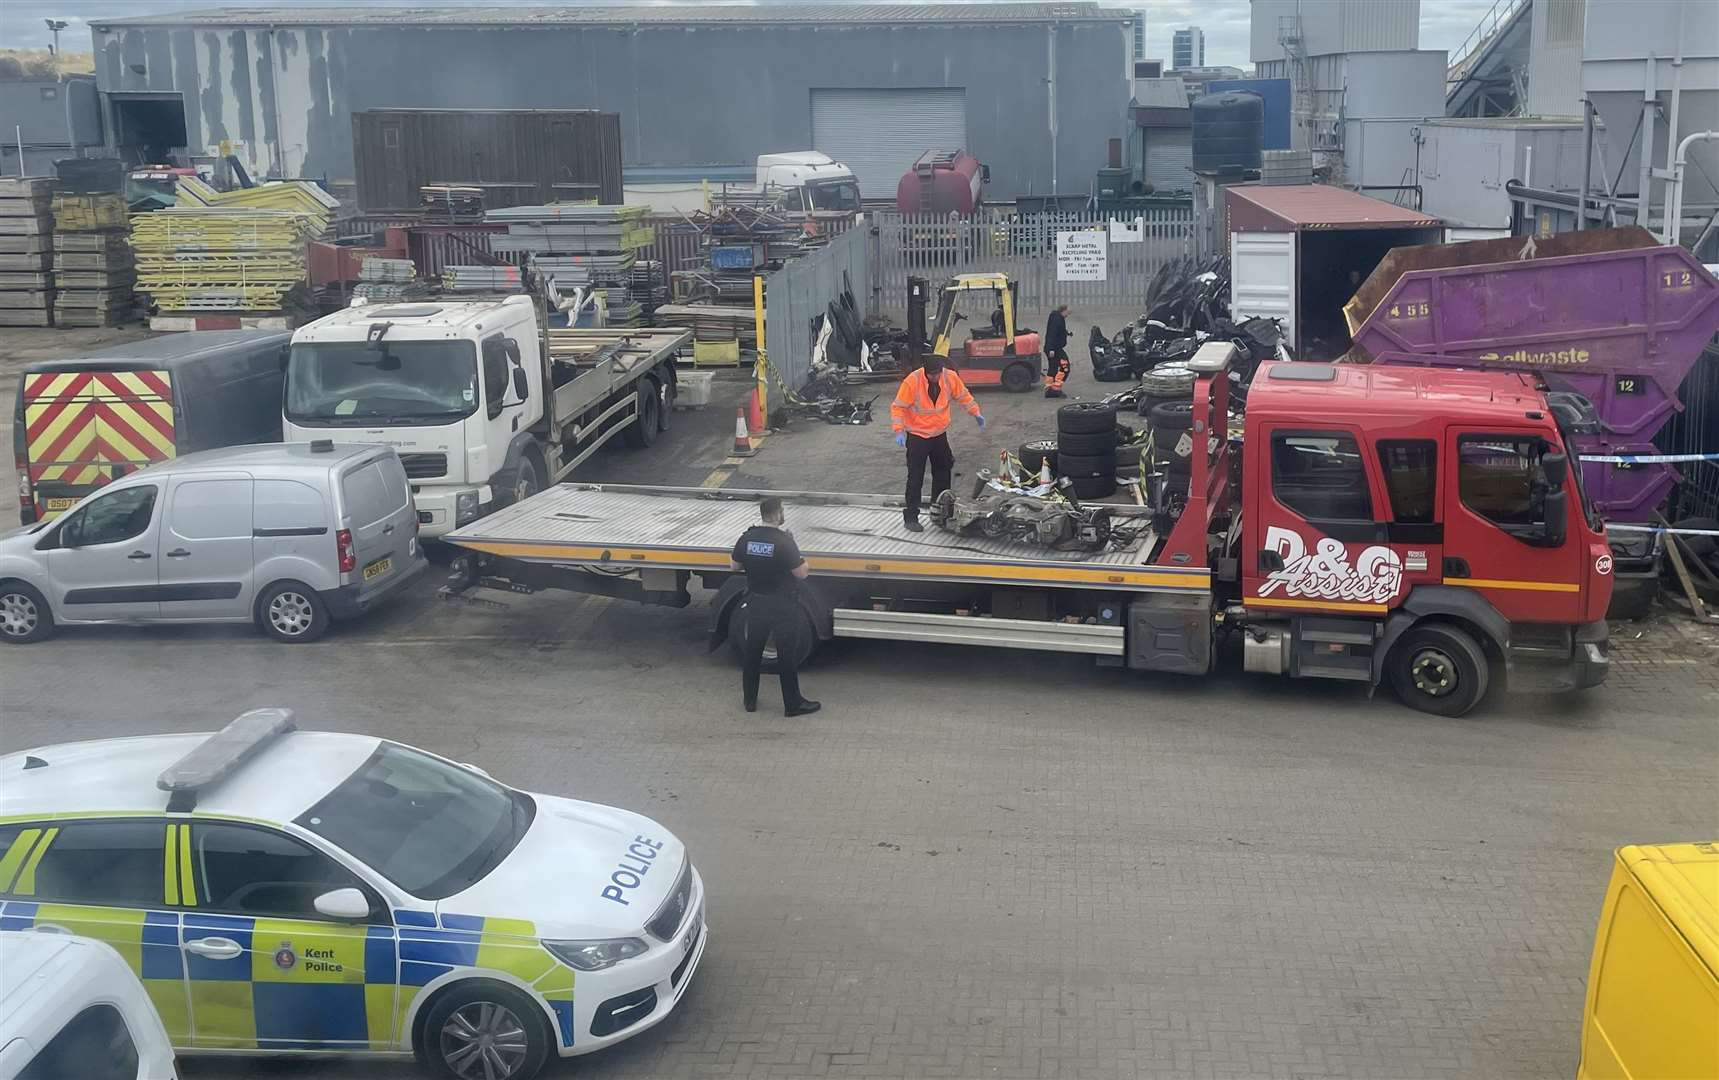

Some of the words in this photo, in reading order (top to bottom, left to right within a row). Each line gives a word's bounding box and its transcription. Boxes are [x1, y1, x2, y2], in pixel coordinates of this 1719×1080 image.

[1618, 380, 1635, 392] 12
[747, 543, 773, 554] POLICE
[1257, 555, 1400, 604] Assist
[600, 835, 664, 906] POLICE
[305, 948, 335, 958] Kent
[305, 962, 343, 972] Police
